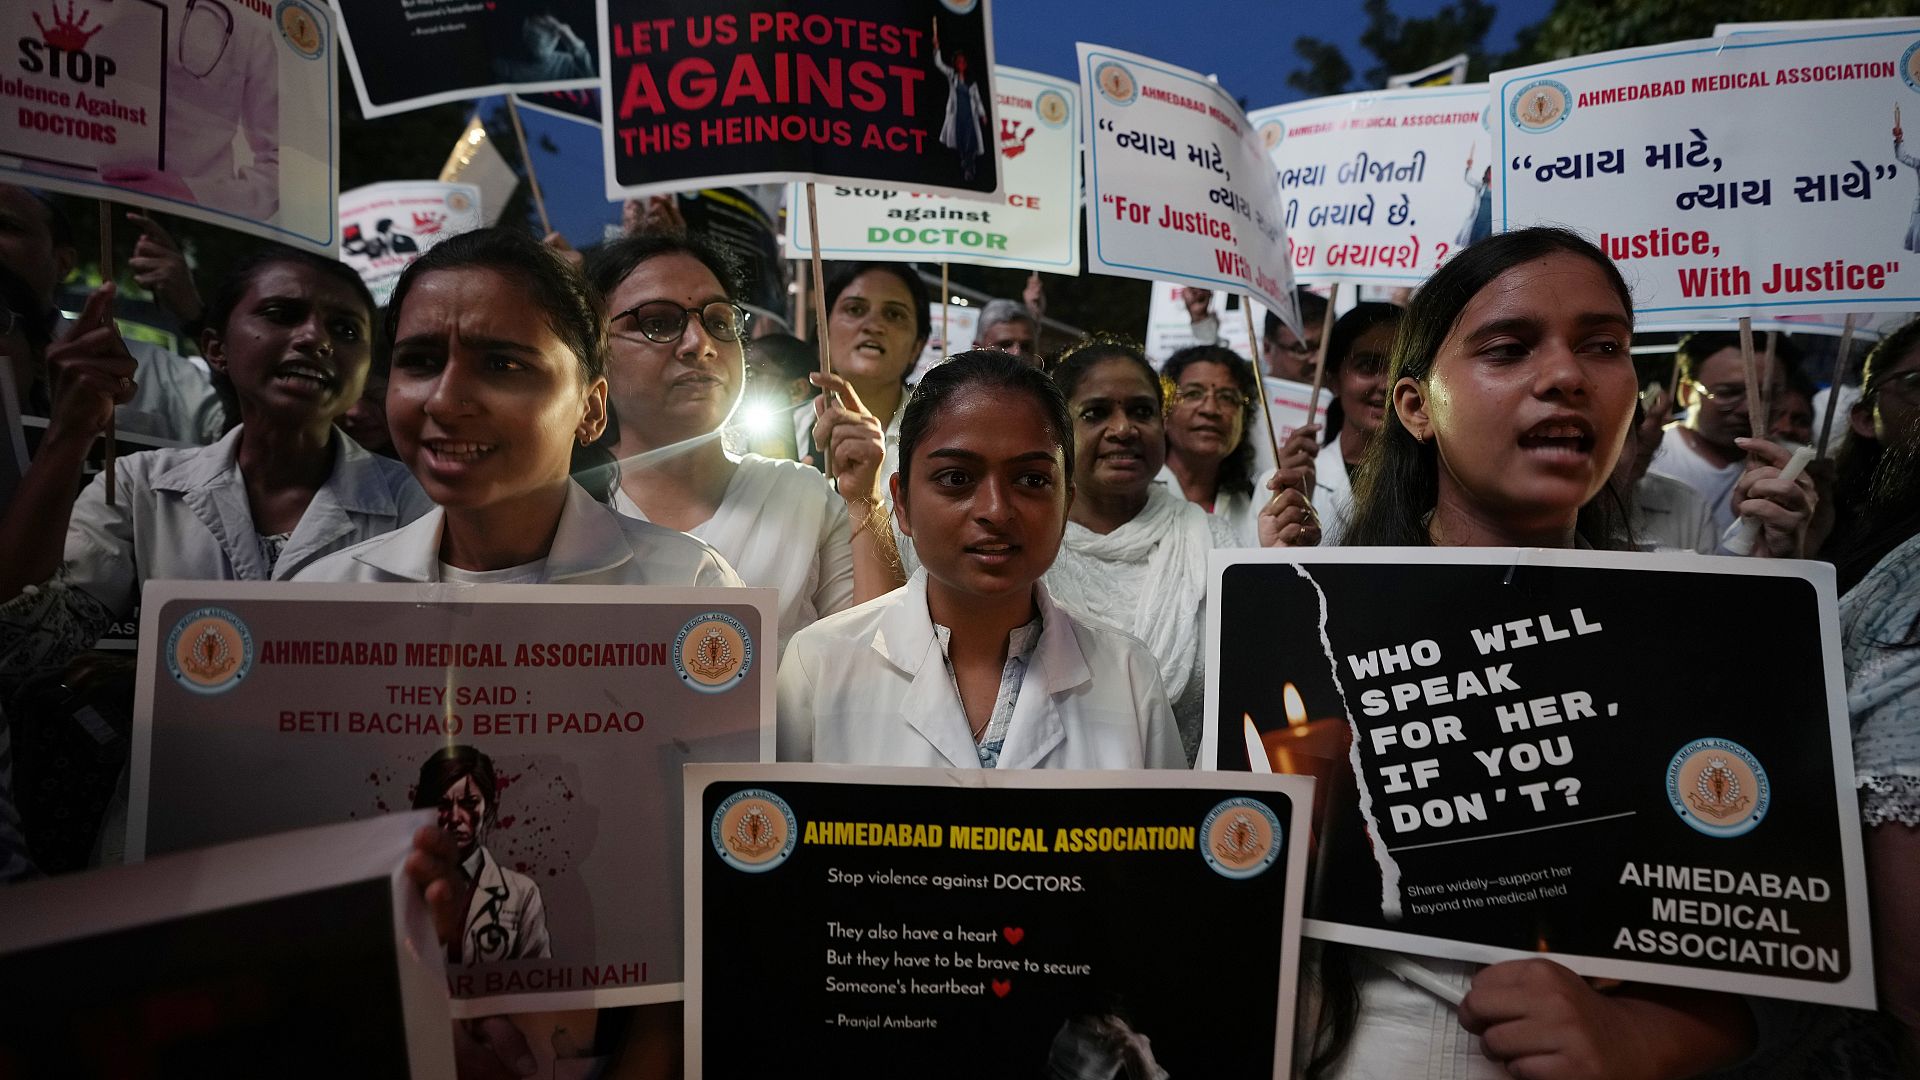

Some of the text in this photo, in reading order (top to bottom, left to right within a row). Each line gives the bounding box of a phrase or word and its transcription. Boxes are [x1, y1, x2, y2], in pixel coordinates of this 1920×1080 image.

[614, 12, 924, 59] LET US PROTEST
[18, 37, 116, 88] STOP
[619, 52, 925, 120] AGAINST
[1142, 85, 1206, 115] AHMEDABAD
[1577, 77, 1685, 109] AHMEDABAD
[1691, 71, 1770, 93] MEDICAL
[1776, 61, 1896, 86] ASSOCIATION
[75, 90, 147, 126] Against
[1401, 112, 1480, 127] ASSOCIATION
[18, 106, 117, 145] DOCTORS
[619, 115, 928, 157] THIS HEINOUS ACT
[834, 184, 898, 200] Stop
[1675, 179, 1772, 211] ન્યાય
[887, 206, 991, 223] against
[1158, 204, 1238, 245] Justice,
[867, 227, 1008, 250] DOCTOR
[1601, 227, 1721, 262] Justice,
[1215, 249, 1252, 283] With
[1678, 261, 1901, 299] With Justice"
[684, 614, 711, 632] MEDICAL
[711, 614, 748, 638] ASSOCIATION
[260, 641, 398, 667] AHMEDABAD
[405, 643, 507, 668] MEDICAL
[514, 643, 667, 668] ASSOCIATION
[1347, 607, 1604, 681] WHO WILL
[386, 686, 447, 706] THEY
[456, 686, 517, 706] SAID
[1360, 662, 1522, 718] SPEAK
[279, 711, 645, 737] BETI BACHAO BETI PADAO
[1369, 689, 1619, 756] FOR HER,
[1379, 735, 1575, 794] IF YOU
[1679, 740, 1712, 760] MEDICAL
[1712, 740, 1761, 772] ASSOCIATION
[1389, 777, 1583, 833] DON'T?
[803, 821, 1195, 852] AHMEDABAD MEDICAL ASSOCIATION
[827, 868, 1086, 892] Stop violence against DOCTORS.
[1407, 885, 1445, 897] Share
[1551, 866, 1572, 877] her
[1619, 862, 1831, 902] AHMEDABAD
[1411, 884, 1567, 914] beyond the medical field
[1652, 897, 1800, 934] MEDICAL
[827, 922, 998, 943] They also have a heart
[826, 950, 1091, 975] But they have to be brave to secure
[1613, 926, 1840, 973] ASSOCIATION
[485, 969, 572, 993] BACHI
[581, 962, 648, 986] NAHI
[825, 976, 985, 995] Someone's heartbeat
[837, 1014, 880, 1030] Pranjal
[883, 1016, 938, 1029] Ambarte
